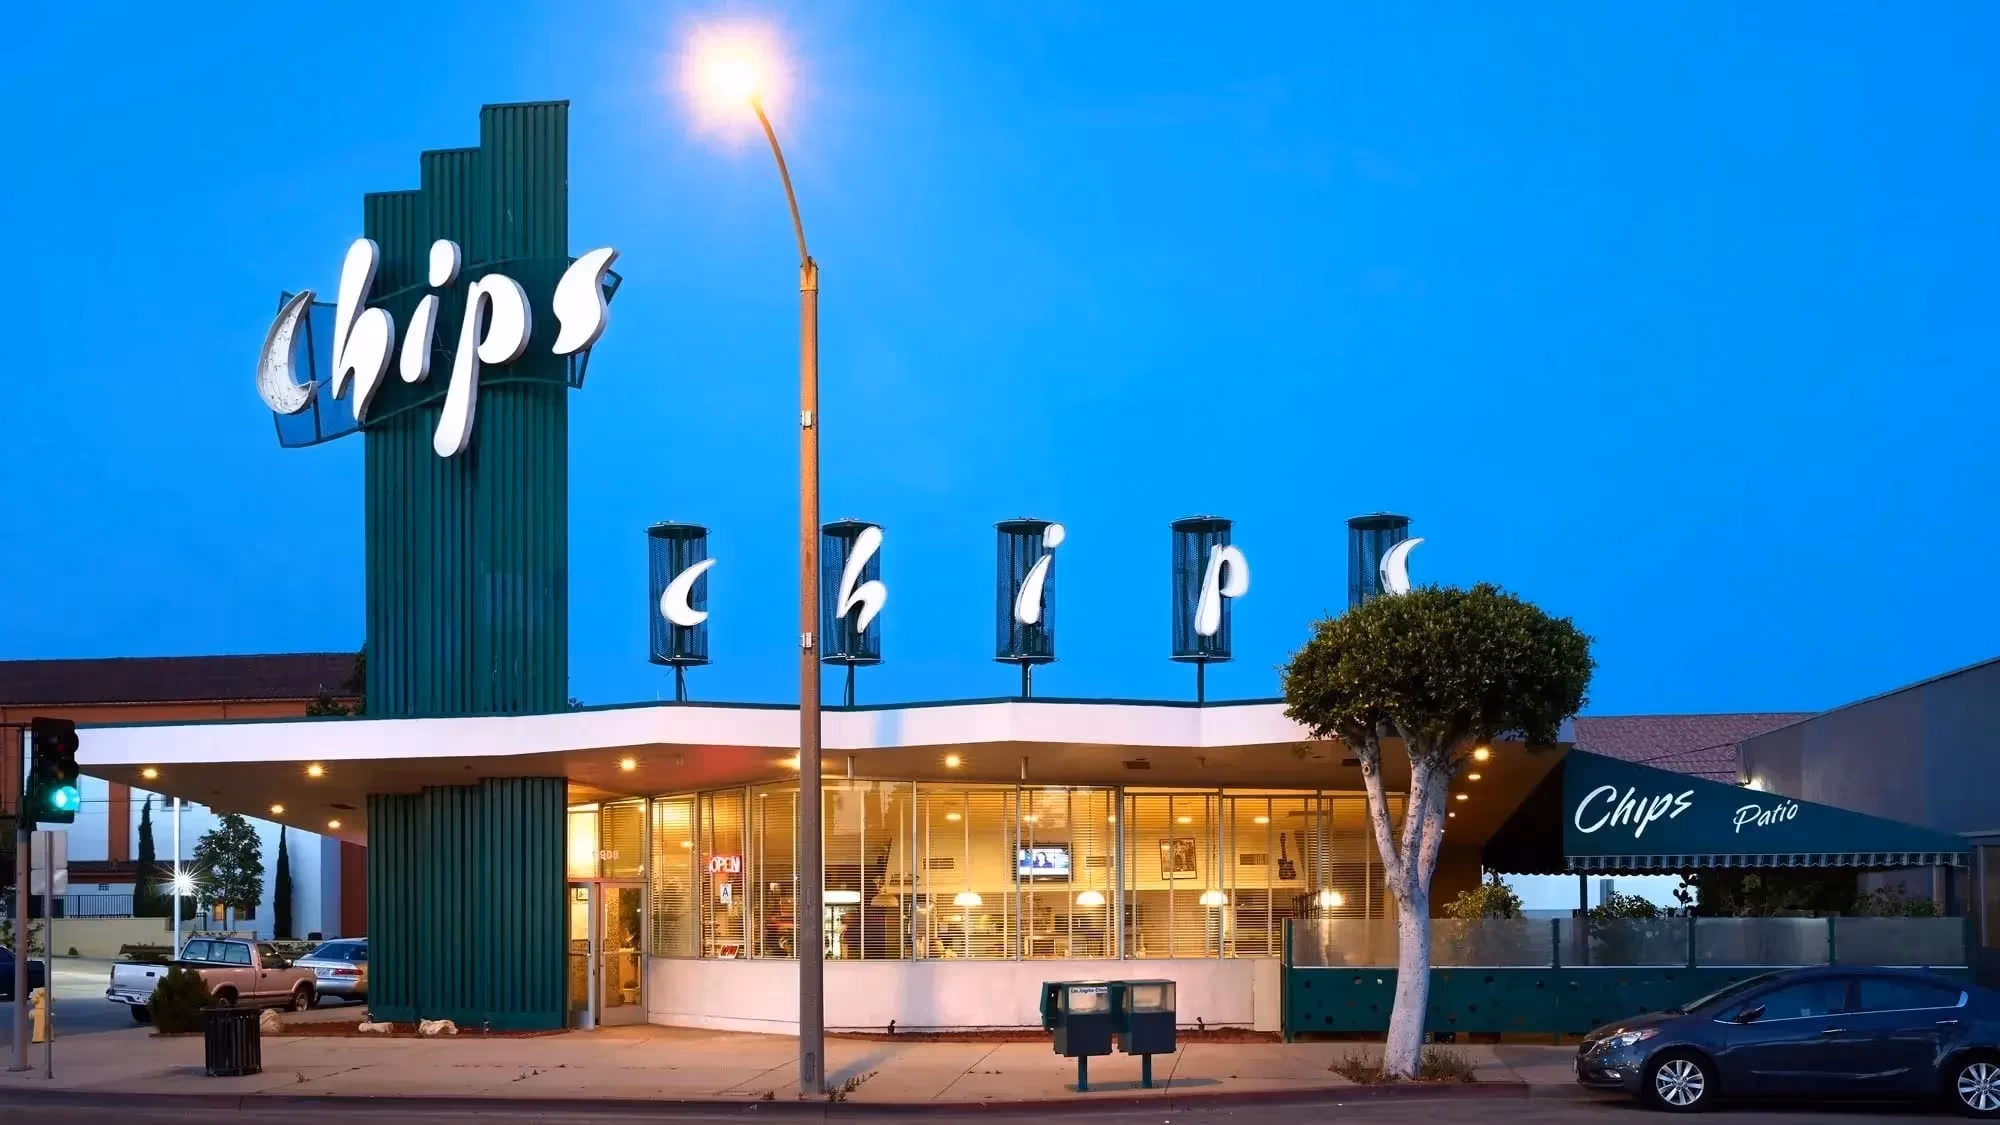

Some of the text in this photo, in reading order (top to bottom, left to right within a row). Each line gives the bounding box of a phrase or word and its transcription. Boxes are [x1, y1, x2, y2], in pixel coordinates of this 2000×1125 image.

[1574, 785, 1799, 838] Chips Patio
[709, 856, 740, 872] OPEN
[722, 887, 729, 897] A
